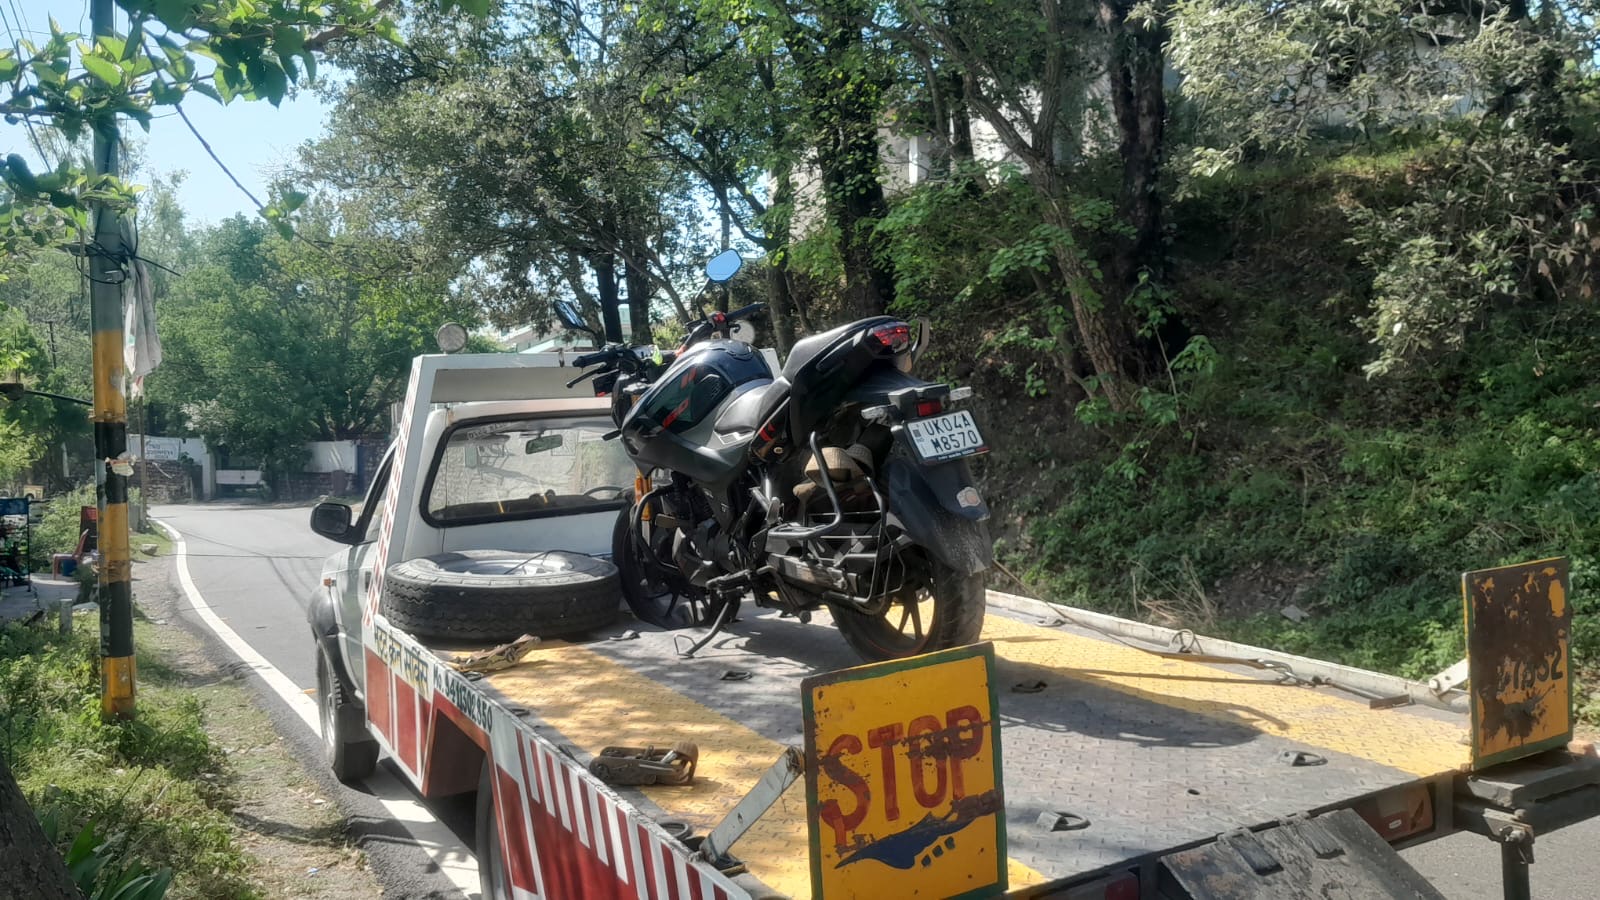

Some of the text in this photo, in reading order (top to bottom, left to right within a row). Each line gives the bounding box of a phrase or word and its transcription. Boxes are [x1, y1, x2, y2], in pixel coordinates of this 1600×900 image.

[922, 413, 970, 435] UK04A
[930, 430, 978, 453] M8570
[820, 705, 984, 834] STOP
